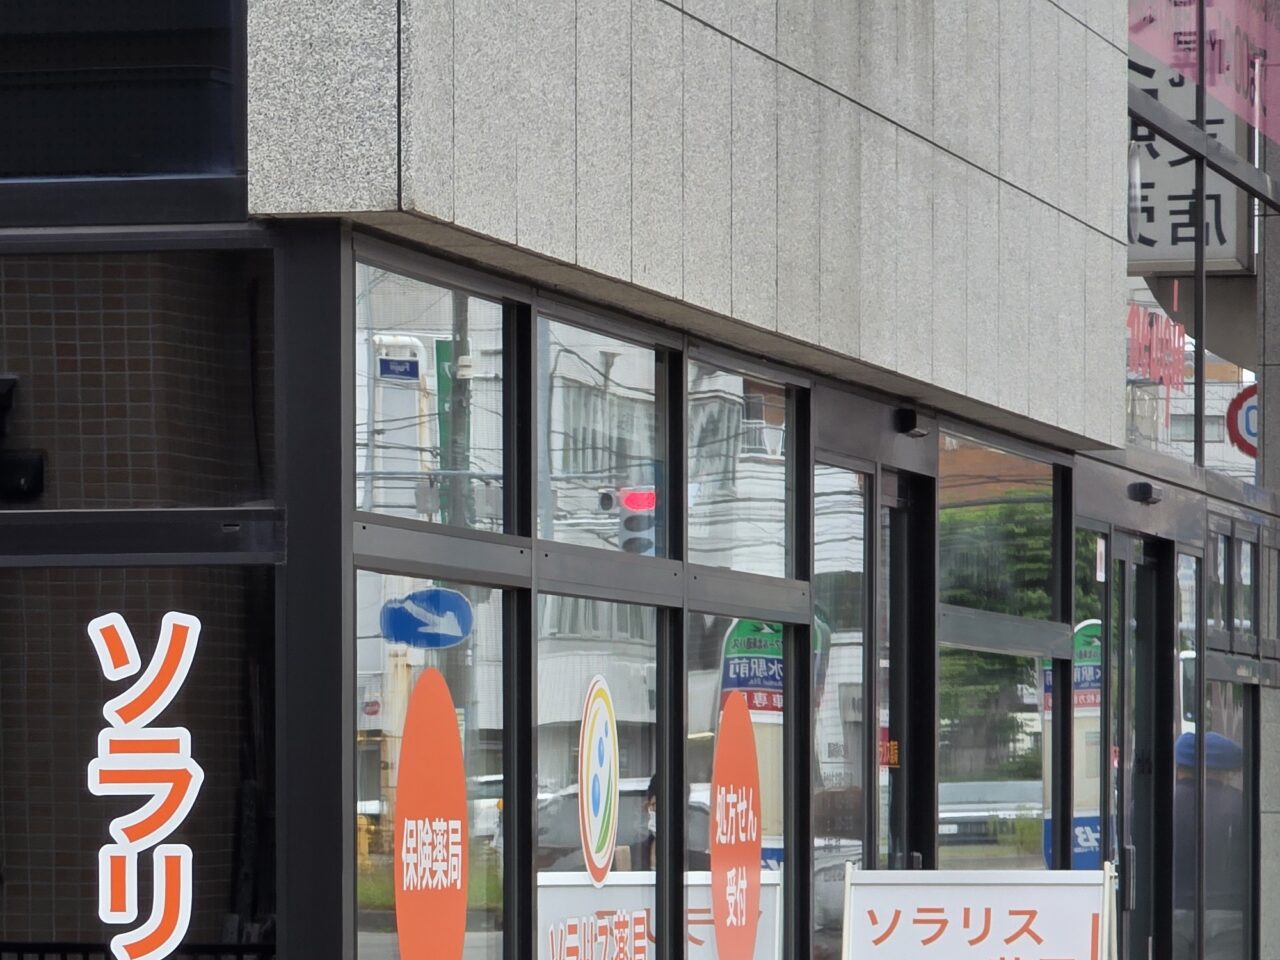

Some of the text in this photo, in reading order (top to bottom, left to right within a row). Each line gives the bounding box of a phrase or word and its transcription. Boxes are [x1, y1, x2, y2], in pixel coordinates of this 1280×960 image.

[716, 784, 757, 845] 処方せん
[402, 817, 462, 891] 保険薬局
[726, 866, 747, 927] 受付
[867, 907, 1044, 946] ソラリス
